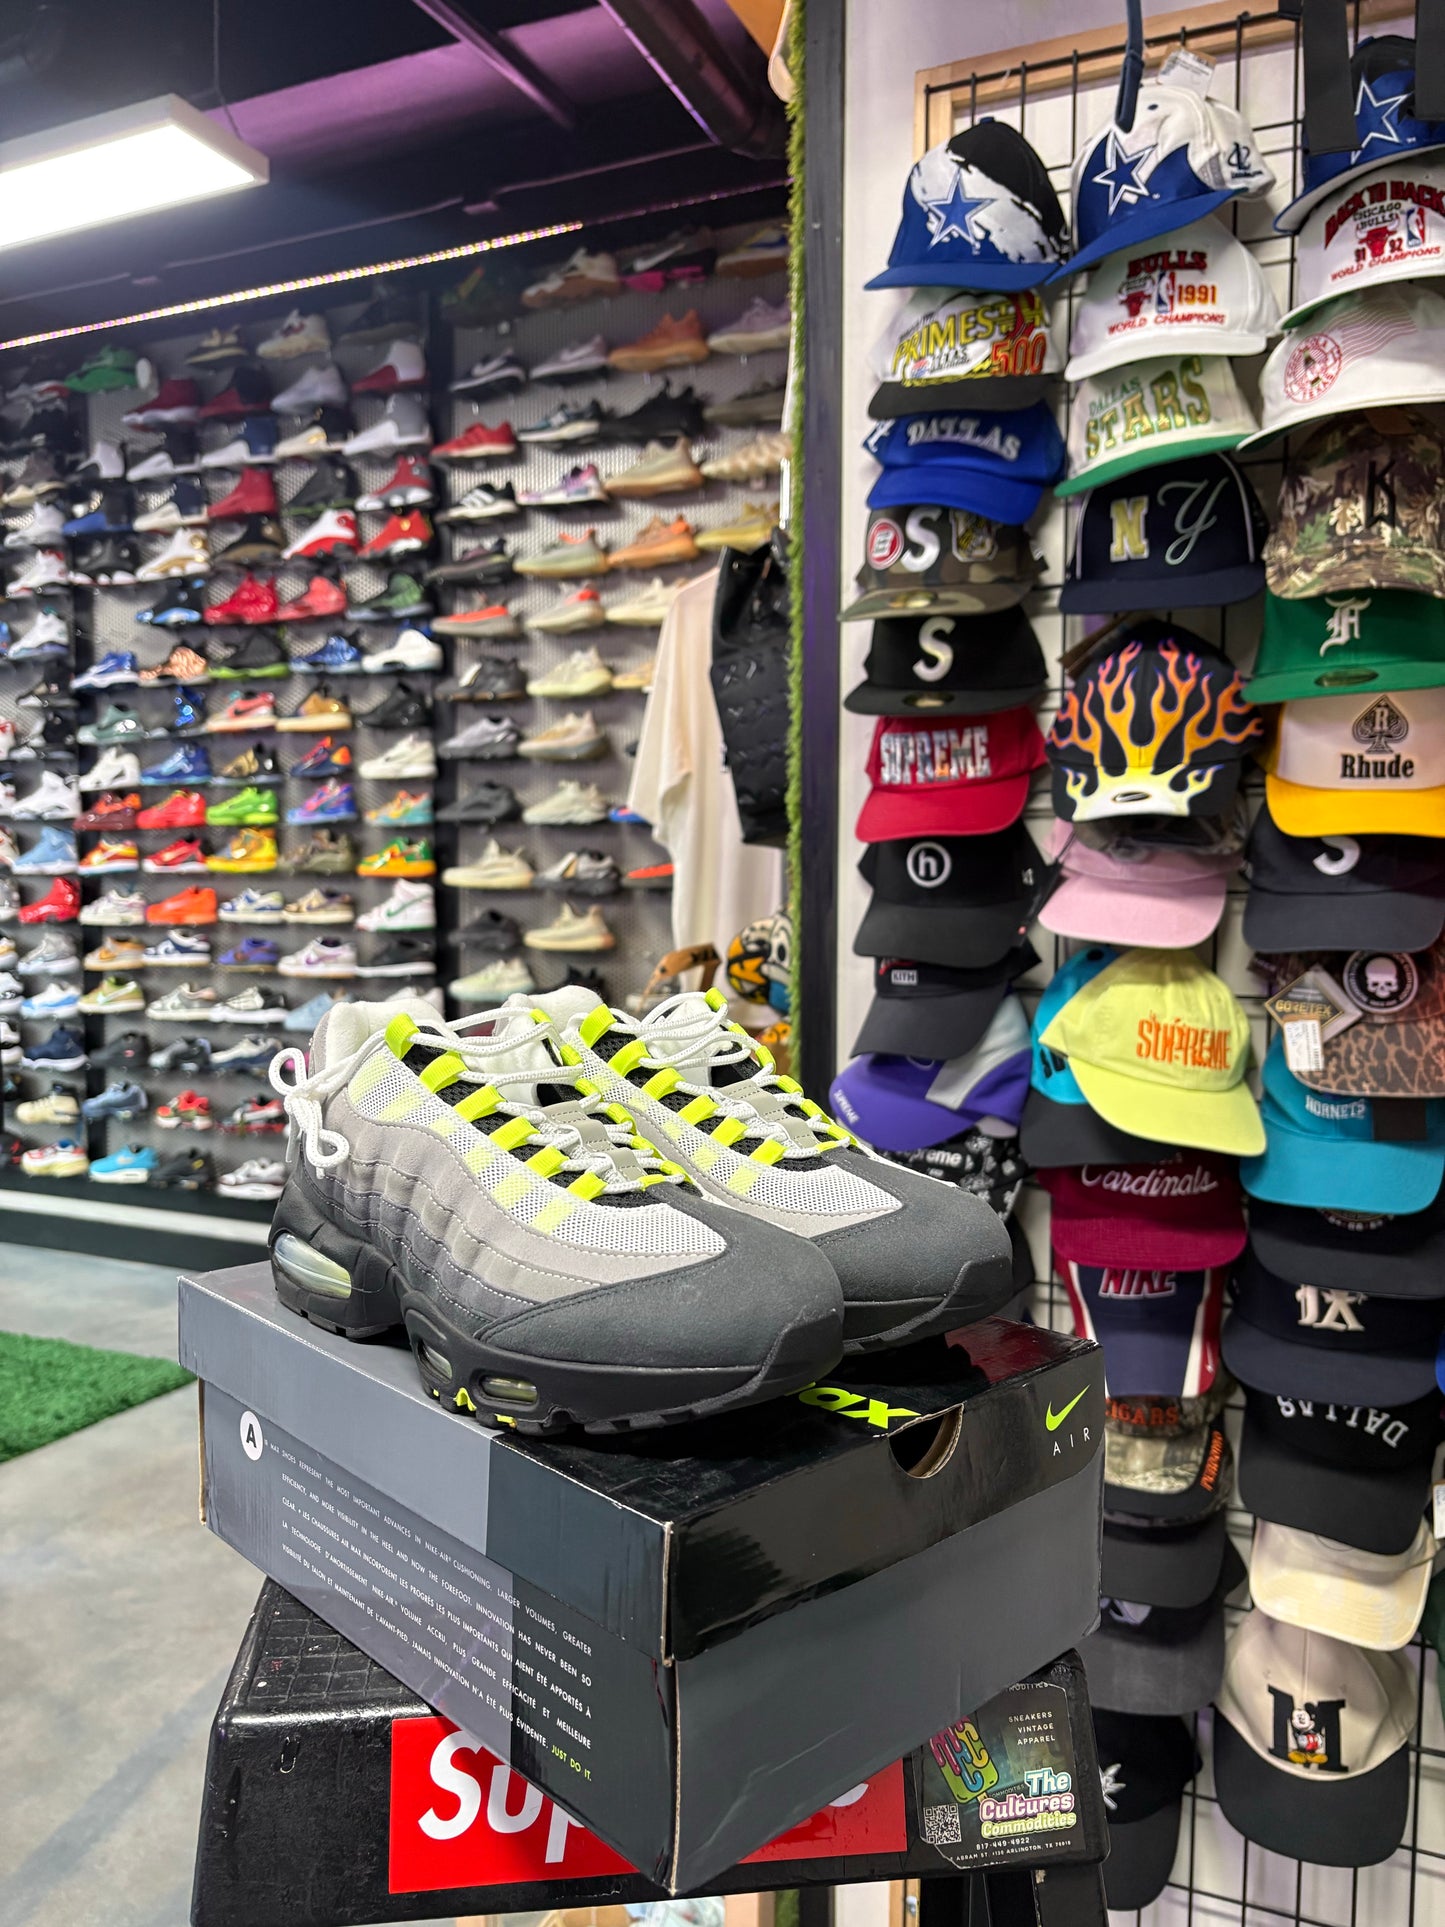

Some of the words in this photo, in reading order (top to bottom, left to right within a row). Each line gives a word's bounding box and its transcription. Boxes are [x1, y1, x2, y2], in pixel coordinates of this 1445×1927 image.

[1353, 202, 1401, 221] CHICAGO
[1126, 250, 1208, 279] BULLS
[1331, 264, 1363, 281] WORLD
[1369, 247, 1440, 267] CHAMPIONS
[1178, 285, 1216, 304] 1991
[1108, 317, 1147, 335] WORLD
[1154, 312, 1226, 325] CHAMPIONS
[991, 332, 1046, 377] 500
[1086, 356, 1211, 460] STARS
[1088, 376, 1140, 416] DALLAS
[907, 416, 1021, 461] DALLAS
[901, 507, 941, 573] S
[1110, 495, 1150, 563] N
[912, 616, 957, 682] S
[880, 726, 991, 785] SUPREME
[1340, 753, 1414, 780] Rhude
[892, 971, 918, 984] KITH
[1305, 1094, 1366, 1119] HORNETS
[1081, 1163, 1218, 1197] Cardinals
[1099, 1267, 1177, 1299] NIKE
[1053, 1427, 1091, 1457] AIR
[282, 1450, 296, 1464] SHOES
[299, 1460, 322, 1480] REPRESENT
[325, 1477, 334, 1488] THE
[337, 1486, 349, 1499] MOST
[353, 1496, 380, 1517] IMPORTANT
[384, 1516, 411, 1538] ADVANCES
[415, 1535, 421, 1544] IN
[497, 1588, 520, 1608] LARGER
[525, 1606, 557, 1634] VOLUMES,
[563, 1631, 591, 1656] GREATER
[310, 1492, 319, 1503] AND
[322, 1500, 335, 1513] MORE
[337, 1509, 359, 1529] VISIBILITY
[361, 1526, 367, 1536] IN
[370, 1531, 378, 1544] THE
[382, 1540, 393, 1554] HEEL
[396, 1550, 408, 1562] AND
[411, 1559, 425, 1573] NOW
[428, 1571, 438, 1583] THE
[476, 1602, 514, 1634] INNOVATION
[518, 1630, 531, 1646] HAS
[535, 1642, 556, 1663] NEVER
[560, 1659, 577, 1677] BEEN
[581, 1674, 591, 1687] SO
[302, 1511, 310, 1521] LES
[311, 1517, 339, 1544] CHAUSSURES
[341, 1538, 349, 1549] AIR
[350, 1545, 361, 1557] MAX
[363, 1552, 397, 1581] INCORPORENT
[400, 1577, 408, 1589] LES
[410, 1585, 434, 1607] PROGRÈS
[436, 1603, 445, 1615] LES
[447, 1611, 460, 1626] PLUS
[463, 1621, 499, 1653] IMPORTANTS
[501, 1649, 513, 1663] QUI
[515, 1659, 534, 1677] AIENT
[536, 1671, 547, 1687] ÉTÉ
[550, 1683, 582, 1712] APPORTÉS
[586, 1706, 591, 1719] À
[282, 1520, 288, 1529] LA
[291, 1526, 321, 1553] TECHNOLOGIE
[325, 1551, 367, 1586] D'AMORTISSEMENT
[400, 1605, 422, 1625] VOLUME
[427, 1624, 447, 1645] ACCRU,
[452, 1642, 466, 1658] PLUS
[471, 1656, 496, 1680] GRANDE
[502, 1678, 536, 1709] EFFICACITÉ
[542, 1707, 550, 1719] ET
[556, 1717, 591, 1749] MEILLEURE
[303, 1559, 309, 1569] DU
[311, 1565, 326, 1581] TALON
[327, 1577, 333, 1586] ET
[334, 1583, 365, 1610] MAINTENANT
[366, 1607, 374, 1617] DE
[412, 1640, 431, 1660] JAMAIS
[434, 1656, 469, 1689] INNOVATION
[472, 1685, 484, 1699] N'A
[486, 1693, 496, 1709] ÉTÉ
[499, 1705, 514, 1722] PLUS
[516, 1717, 549, 1749] ÉVIDENTE.
[551, 1744, 567, 1763] JUST
[570, 1758, 581, 1773] DO
[584, 1768, 592, 1782] IT.
[1008, 1711, 1053, 1723] SNEAKERS
[1018, 1722, 1054, 1734] VINTAGE
[1017, 1734, 1056, 1746] APPAREL
[1025, 1768, 1071, 1797] The
[980, 1794, 1074, 1822] Cultures
[981, 1812, 1076, 1839] Commodities
[956, 1853, 978, 1862] ABRAM
[976, 1836, 1030, 1851] 817-449-4922
